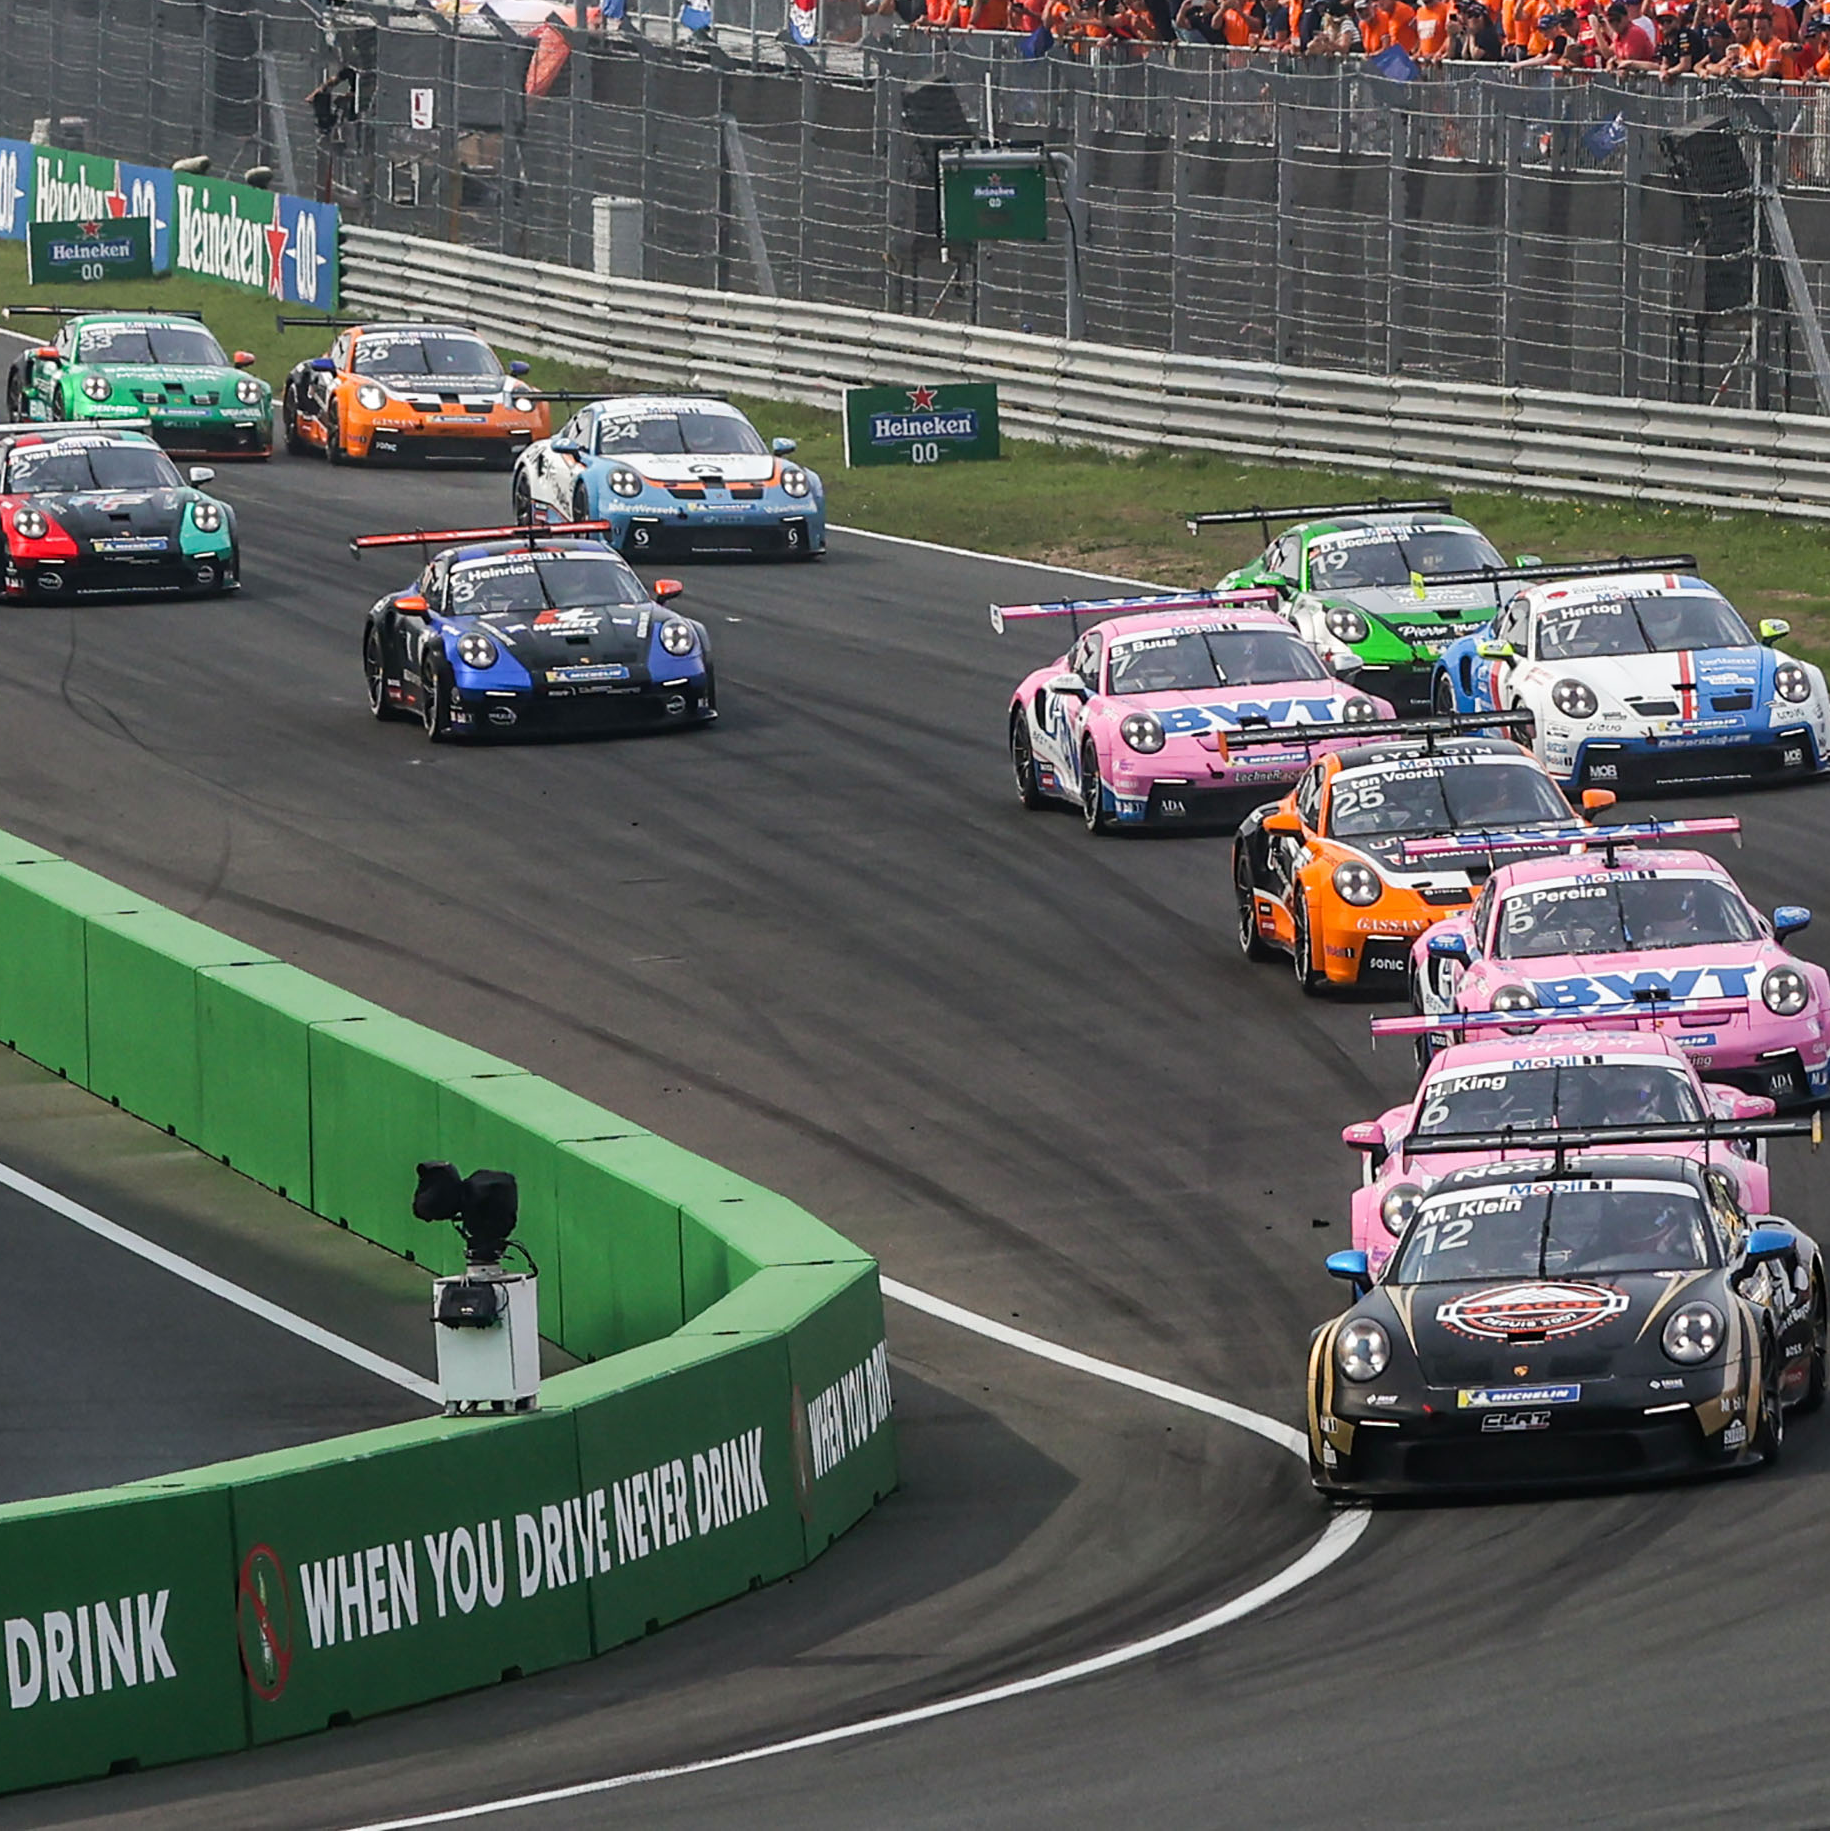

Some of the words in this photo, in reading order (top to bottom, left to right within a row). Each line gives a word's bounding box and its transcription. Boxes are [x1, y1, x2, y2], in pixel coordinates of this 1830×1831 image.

[177, 184, 264, 288] Heineken
[53, 240, 130, 260] Heineken
[80, 335, 114, 351] 33
[355, 347, 389, 364] 26
[601, 423, 640, 442] 24
[875, 415, 972, 438] Heineken
[912, 442, 938, 464] 0.0
[1320, 541, 1335, 553] D.
[468, 564, 535, 582] Heinrich
[1310, 551, 1350, 575] 19
[452, 583, 476, 603] 3
[1596, 589, 1643, 601] Mobil
[1560, 603, 1622, 620] Hartog
[1170, 623, 1220, 635] Mobil
[1540, 619, 1582, 645] 17
[1111, 645, 1129, 659] B.
[1131, 637, 1178, 654] Buus
[1108, 653, 1133, 677] 7
[1157, 697, 1337, 735] BWT
[1250, 752, 1306, 764] MICHELIN
[1370, 745, 1494, 763] SYSOIN
[1398, 756, 1455, 769] Mobil
[1351, 775, 1380, 790] ten
[1382, 767, 1445, 785] Voorde
[1589, 765, 1618, 778] MOB
[1161, 800, 1186, 813] ADA
[1335, 787, 1386, 818] 25
[1575, 870, 1633, 885] Mobil
[1506, 898, 1528, 912] D.
[1532, 884, 1608, 907] Pereira
[1506, 907, 1536, 935] 5
[1532, 964, 1758, 1008] BWT
[1512, 1053, 1577, 1069] Mobil
[1425, 1083, 1448, 1100] H.
[1453, 1073, 1507, 1094] King
[1770, 1073, 1794, 1090] ADA
[1420, 1096, 1451, 1127] 6
[1508, 1179, 1583, 1197] Mobil
[1421, 1203, 1453, 1226] M.
[1457, 1196, 1522, 1220] Klein
[1415, 1219, 1473, 1257] 12
[1491, 1387, 1570, 1402] MICHELIN
[807, 1381, 846, 1480] WHEN
[840, 1363, 868, 1451] YOU
[299, 1539, 419, 1649] WHEN
[424, 1519, 505, 1617] YOU
[516, 1489, 612, 1598] DRIVE
[614, 1458, 692, 1565] NEVER
[692, 1426, 770, 1536] DRINK
[5, 1588, 177, 1710] DRINK
